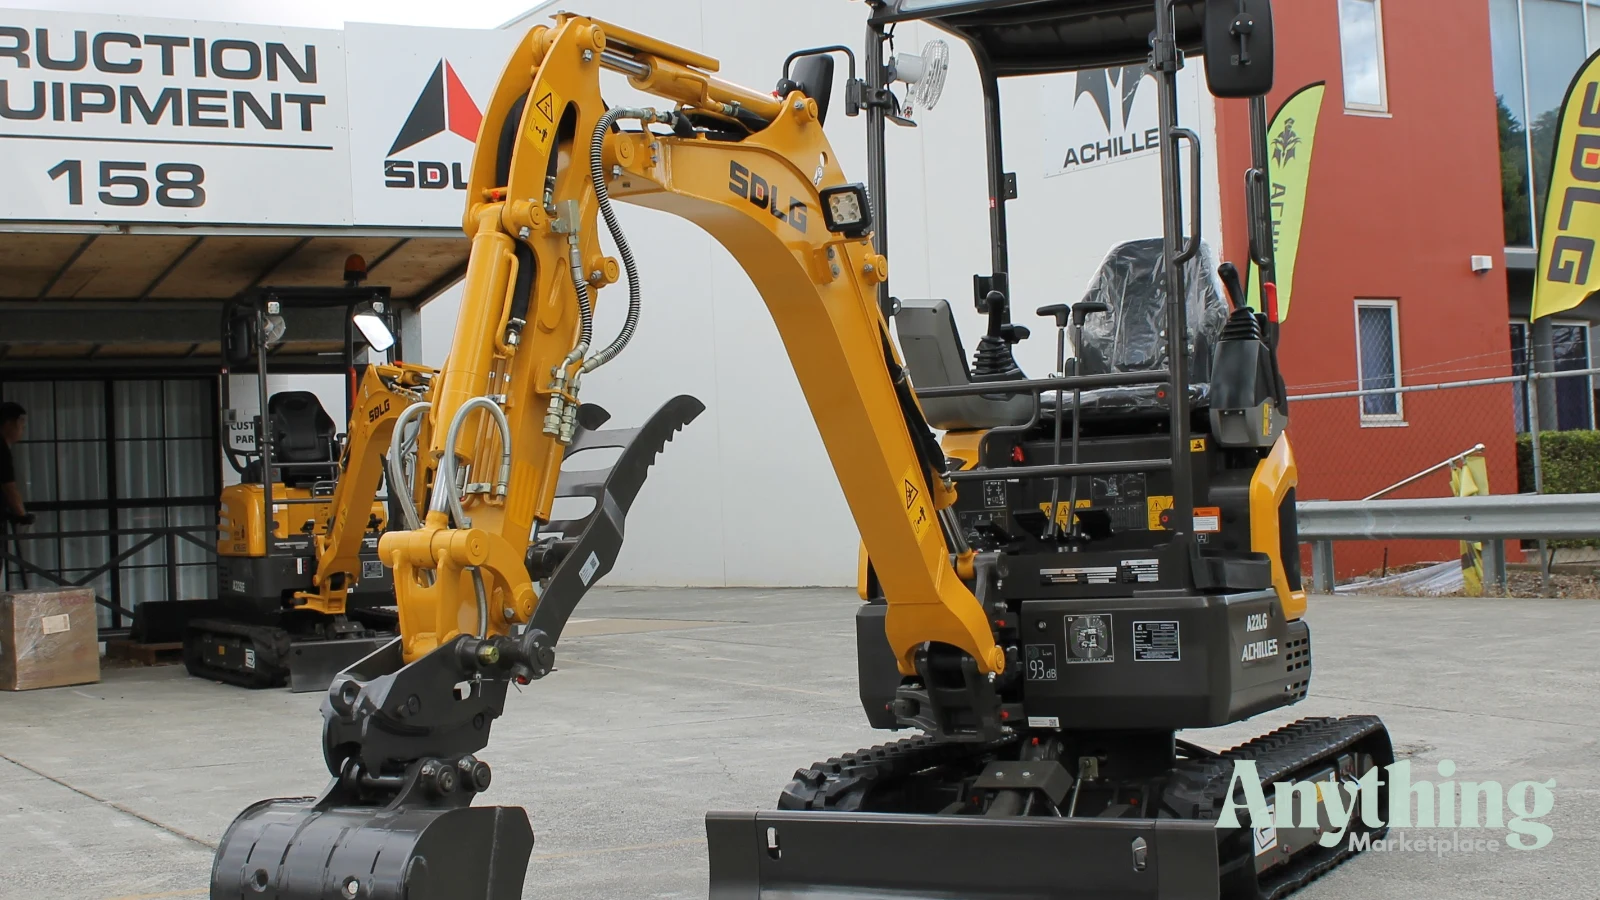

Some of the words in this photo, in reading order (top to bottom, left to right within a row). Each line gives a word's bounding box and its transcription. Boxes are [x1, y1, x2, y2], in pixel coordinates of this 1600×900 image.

[0, 26, 317, 84] RUCTION
[0, 79, 326, 132] UIPMENT
[1063, 127, 1160, 168] ACHILLE
[47, 160, 206, 208] 158
[729, 160, 808, 234] SDLG
[368, 398, 390, 423] SDLG
[1246, 612, 1268, 632] A22LG
[1241, 638, 1279, 662] ACHILLES
